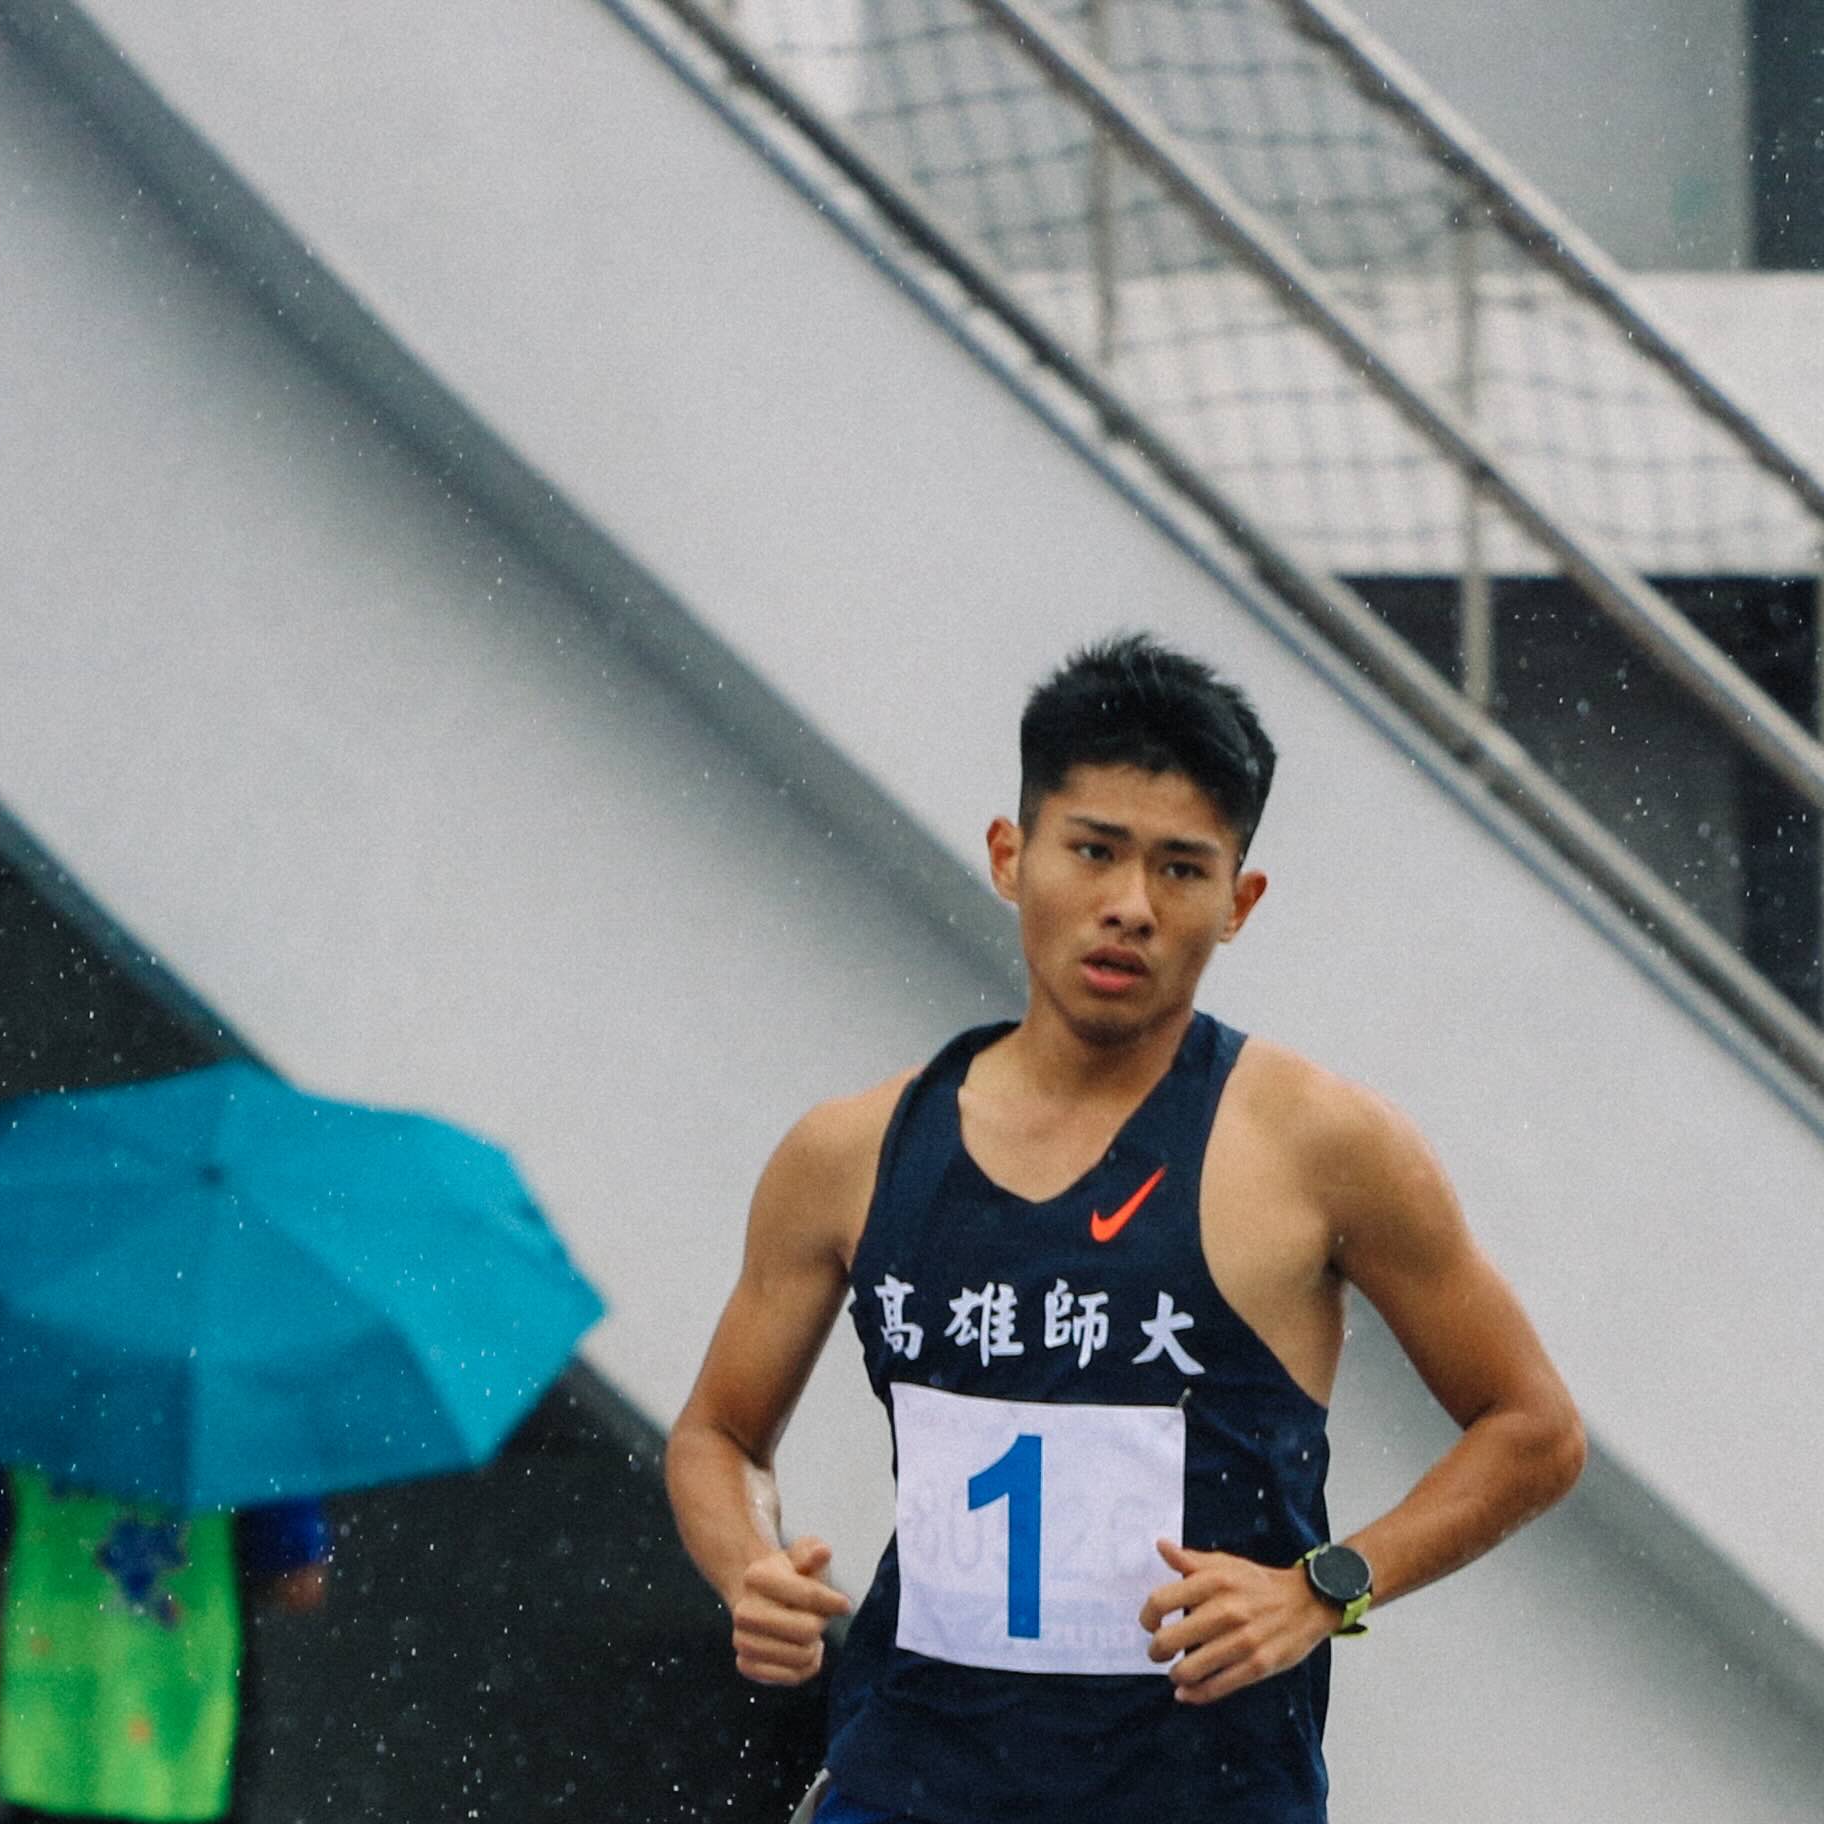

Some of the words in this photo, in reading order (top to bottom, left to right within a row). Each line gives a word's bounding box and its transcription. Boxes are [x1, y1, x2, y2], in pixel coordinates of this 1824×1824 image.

[874, 1273, 1206, 1375] 高雄師大
[967, 1433, 1042, 1639] 1
